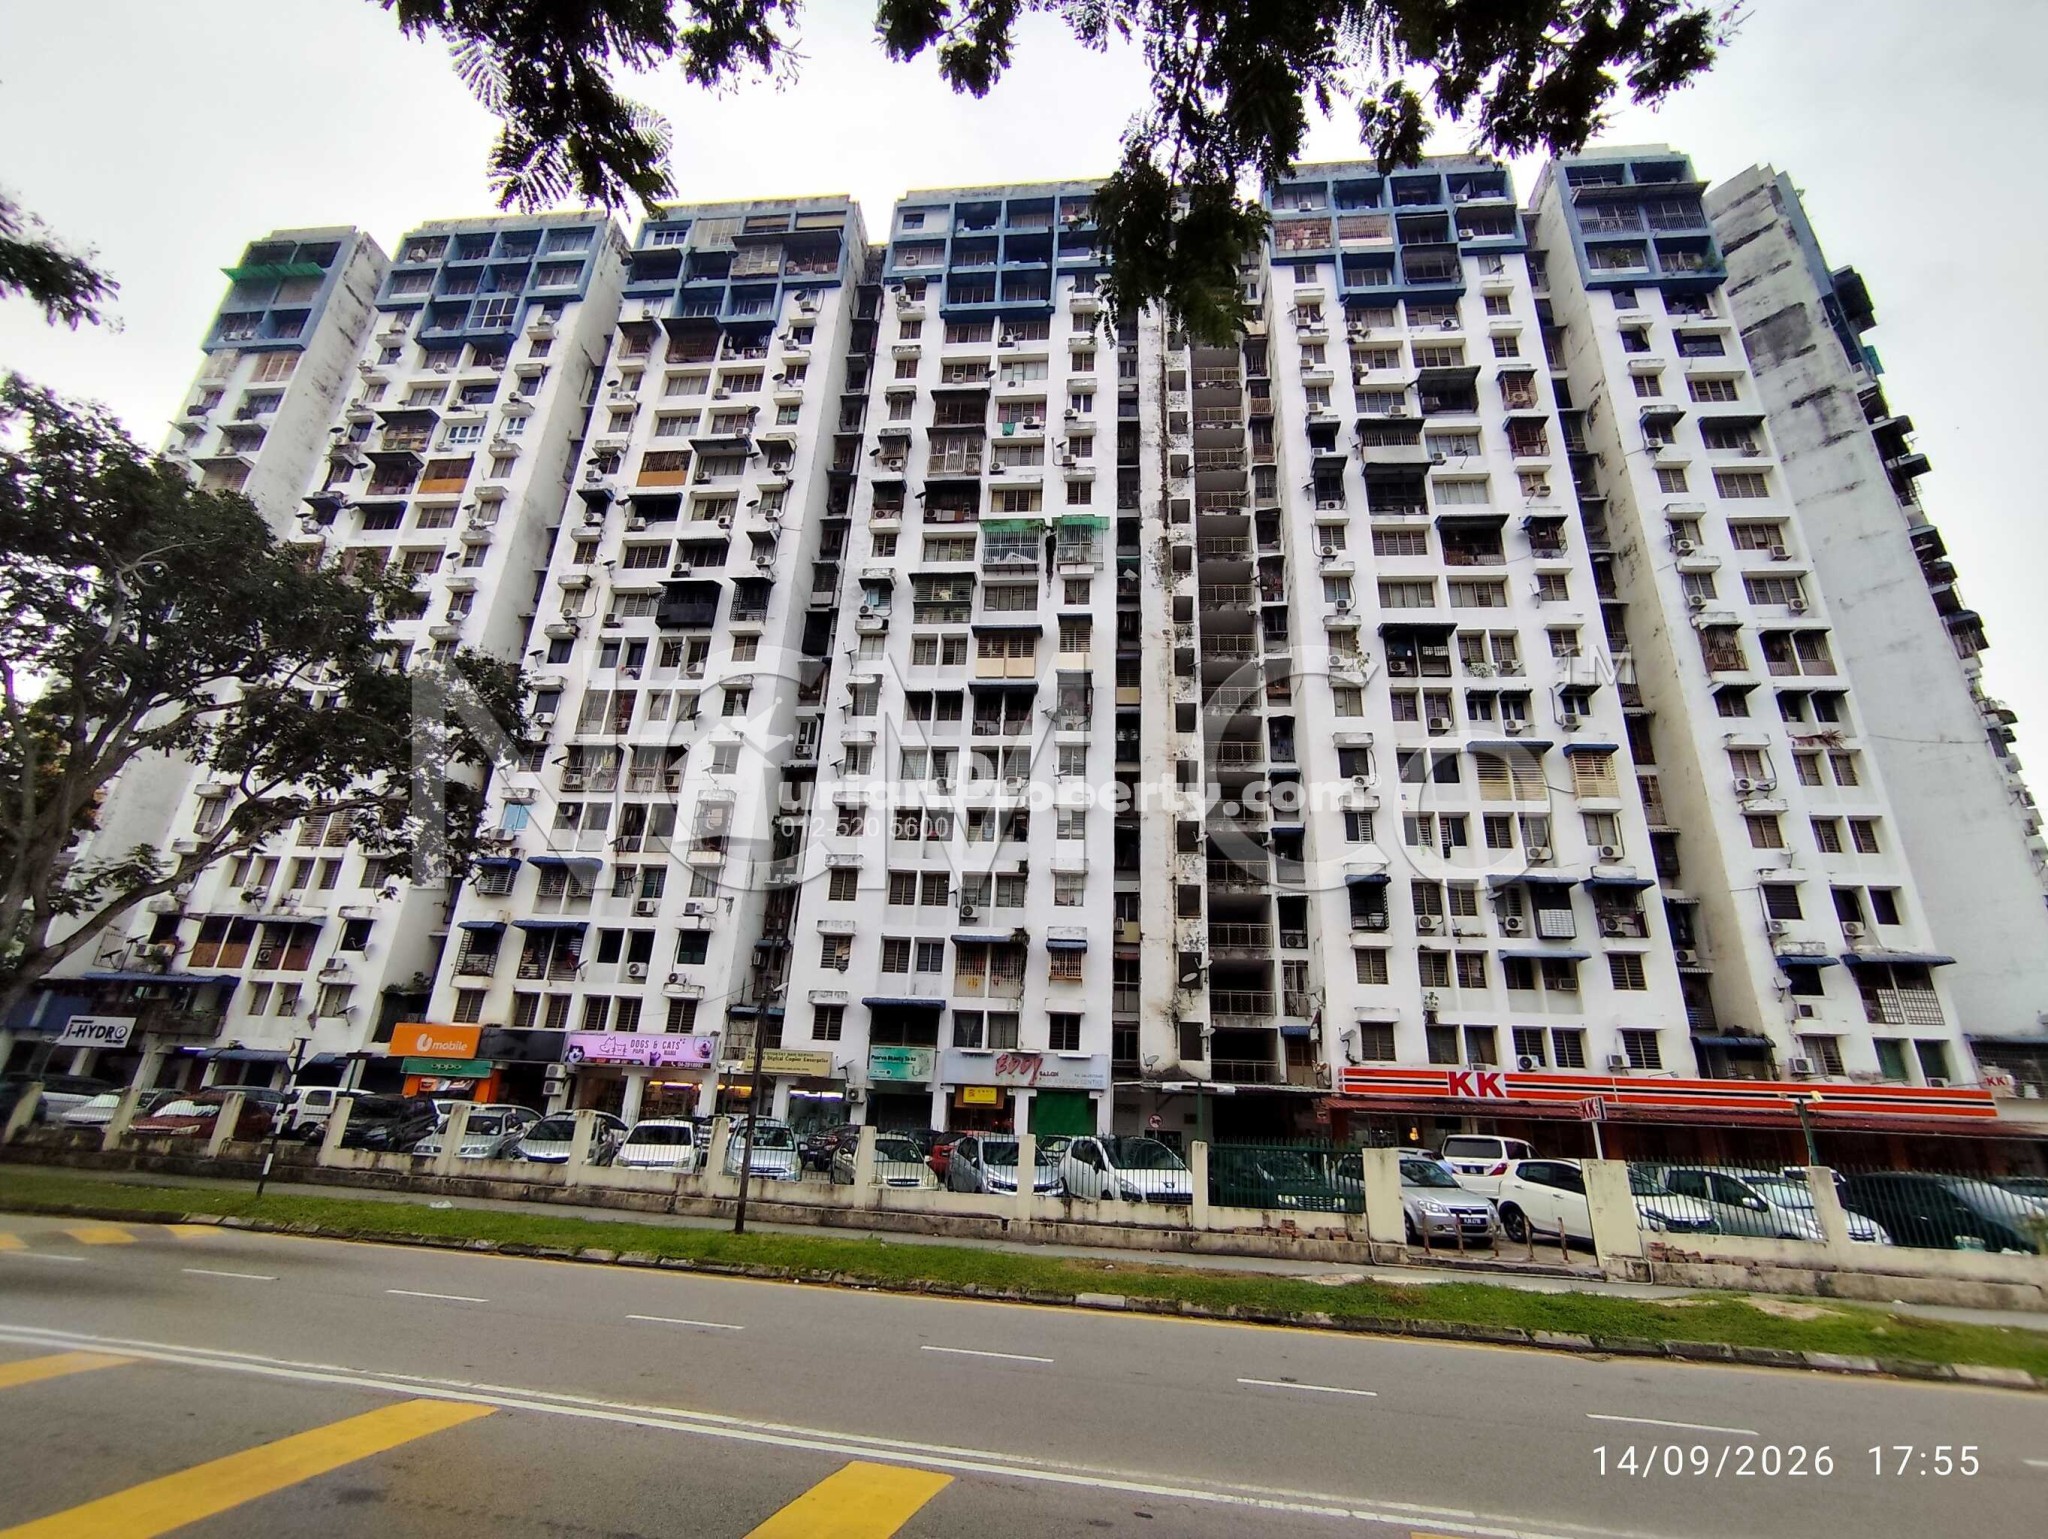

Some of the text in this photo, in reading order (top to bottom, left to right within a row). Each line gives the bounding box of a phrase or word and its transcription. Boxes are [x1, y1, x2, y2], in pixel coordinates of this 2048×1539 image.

[629, 1038, 650, 1049] DOGS
[662, 1040, 681, 1051] CATS
[1450, 1071, 1505, 1098] KK
